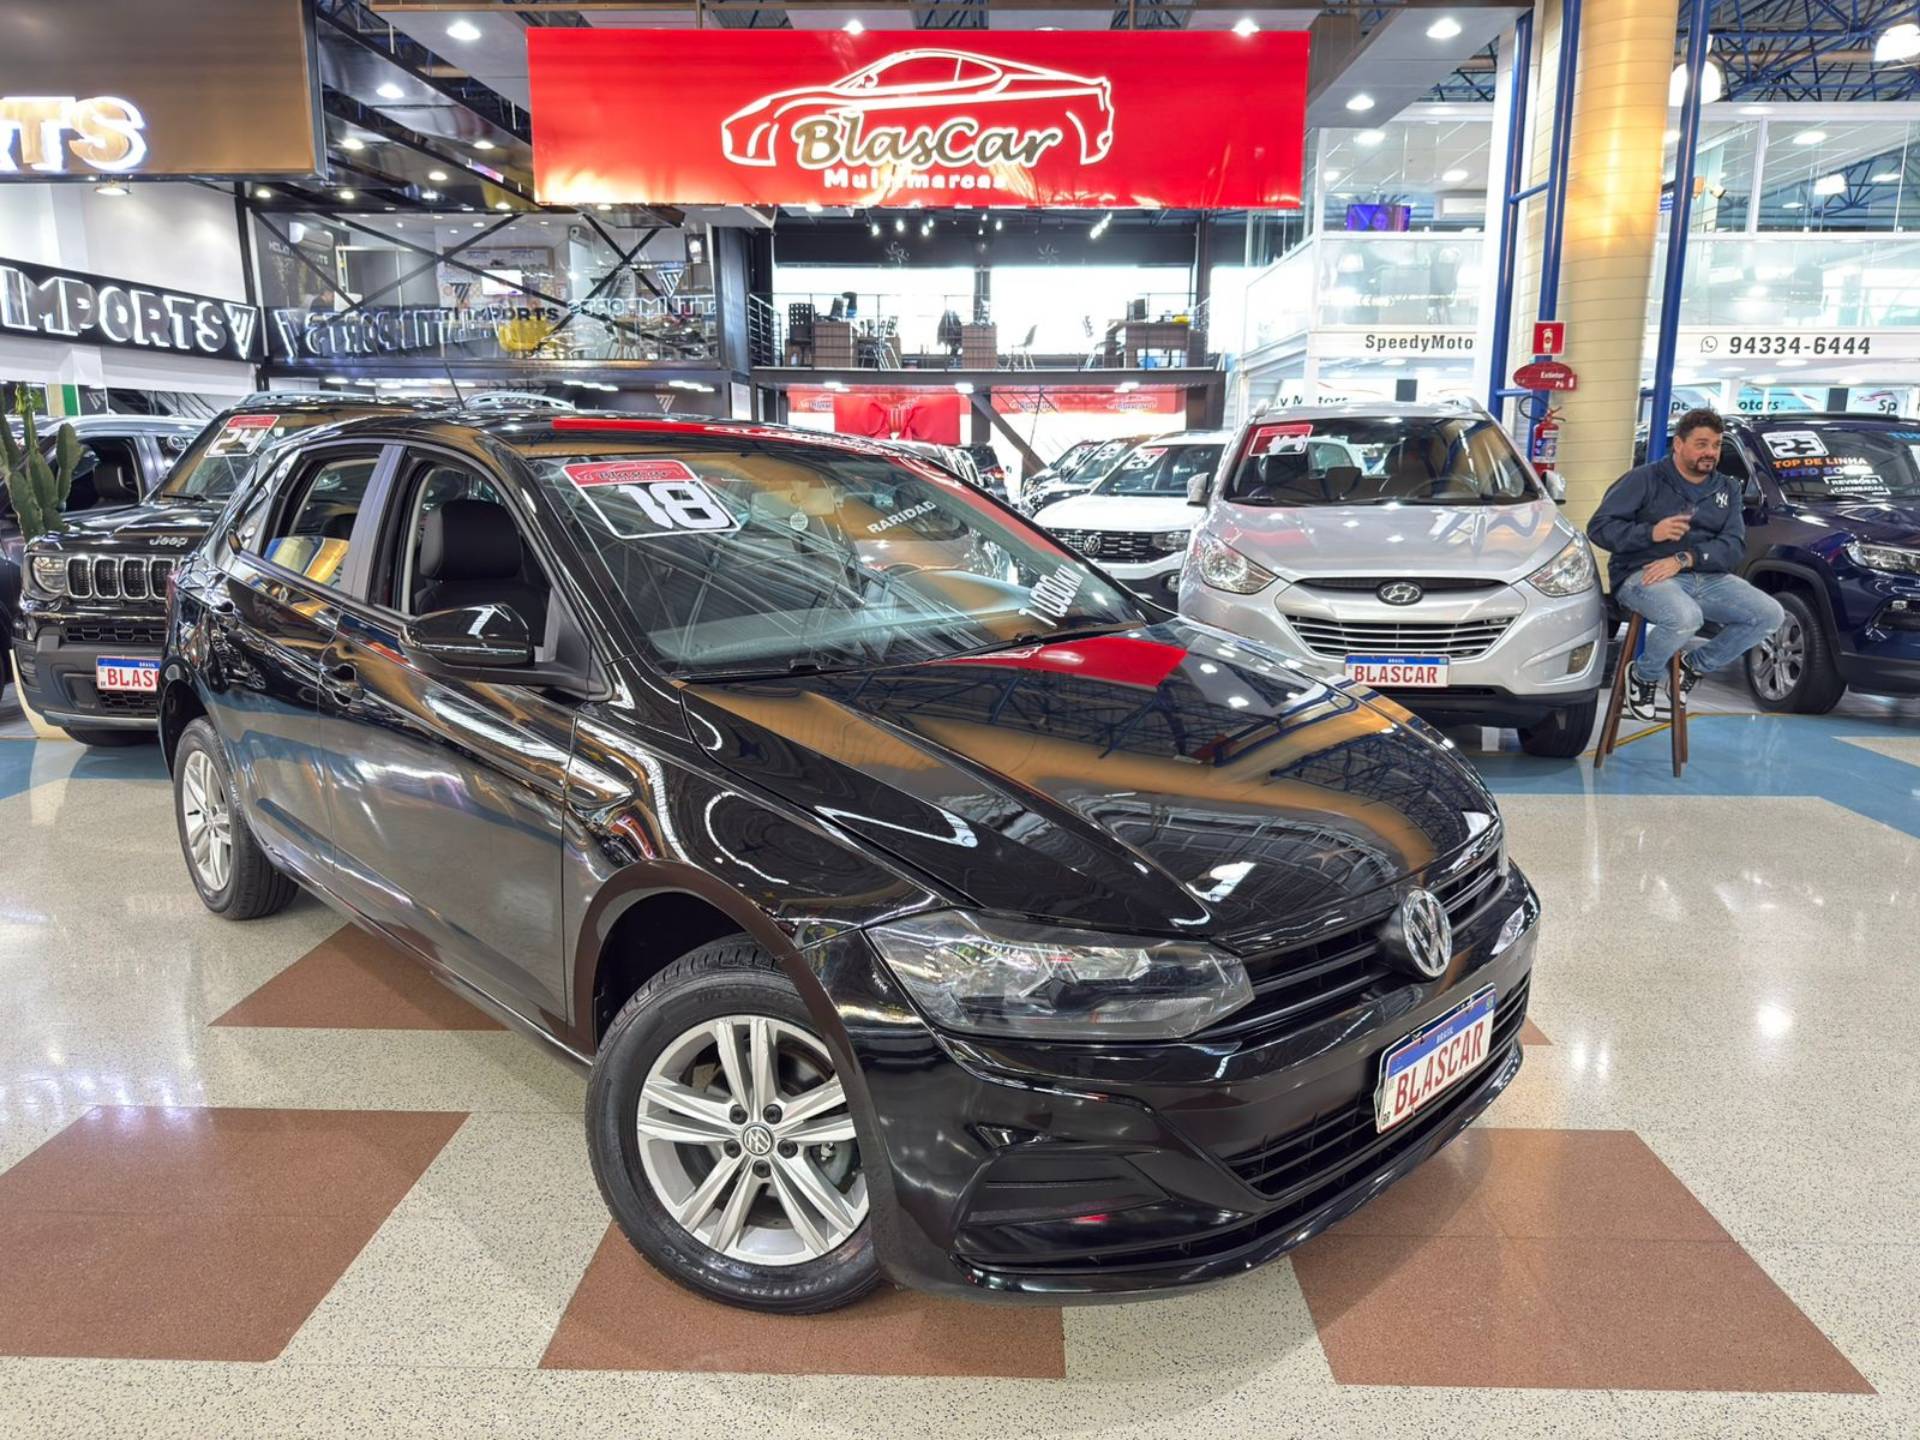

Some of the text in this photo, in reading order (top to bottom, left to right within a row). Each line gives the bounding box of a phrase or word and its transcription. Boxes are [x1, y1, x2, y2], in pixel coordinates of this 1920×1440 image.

[792, 110, 1063, 169] BlasCar
[824, 168, 1007, 190] Mulmarcas
[0, 264, 228, 352] IMPORTS
[1366, 334, 1474, 352] SpeedyMoto
[1729, 335, 1872, 355] 94334-6444
[209, 428, 266, 455] 24
[1773, 438, 1825, 456] 23
[1773, 457, 1868, 468] TOP DE LINHA
[618, 482, 731, 530] 18
[149, 535, 189, 547] Jeep
[1354, 665, 1438, 684] BLASCAR
[1393, 1020, 1484, 1117] BLASCAR
